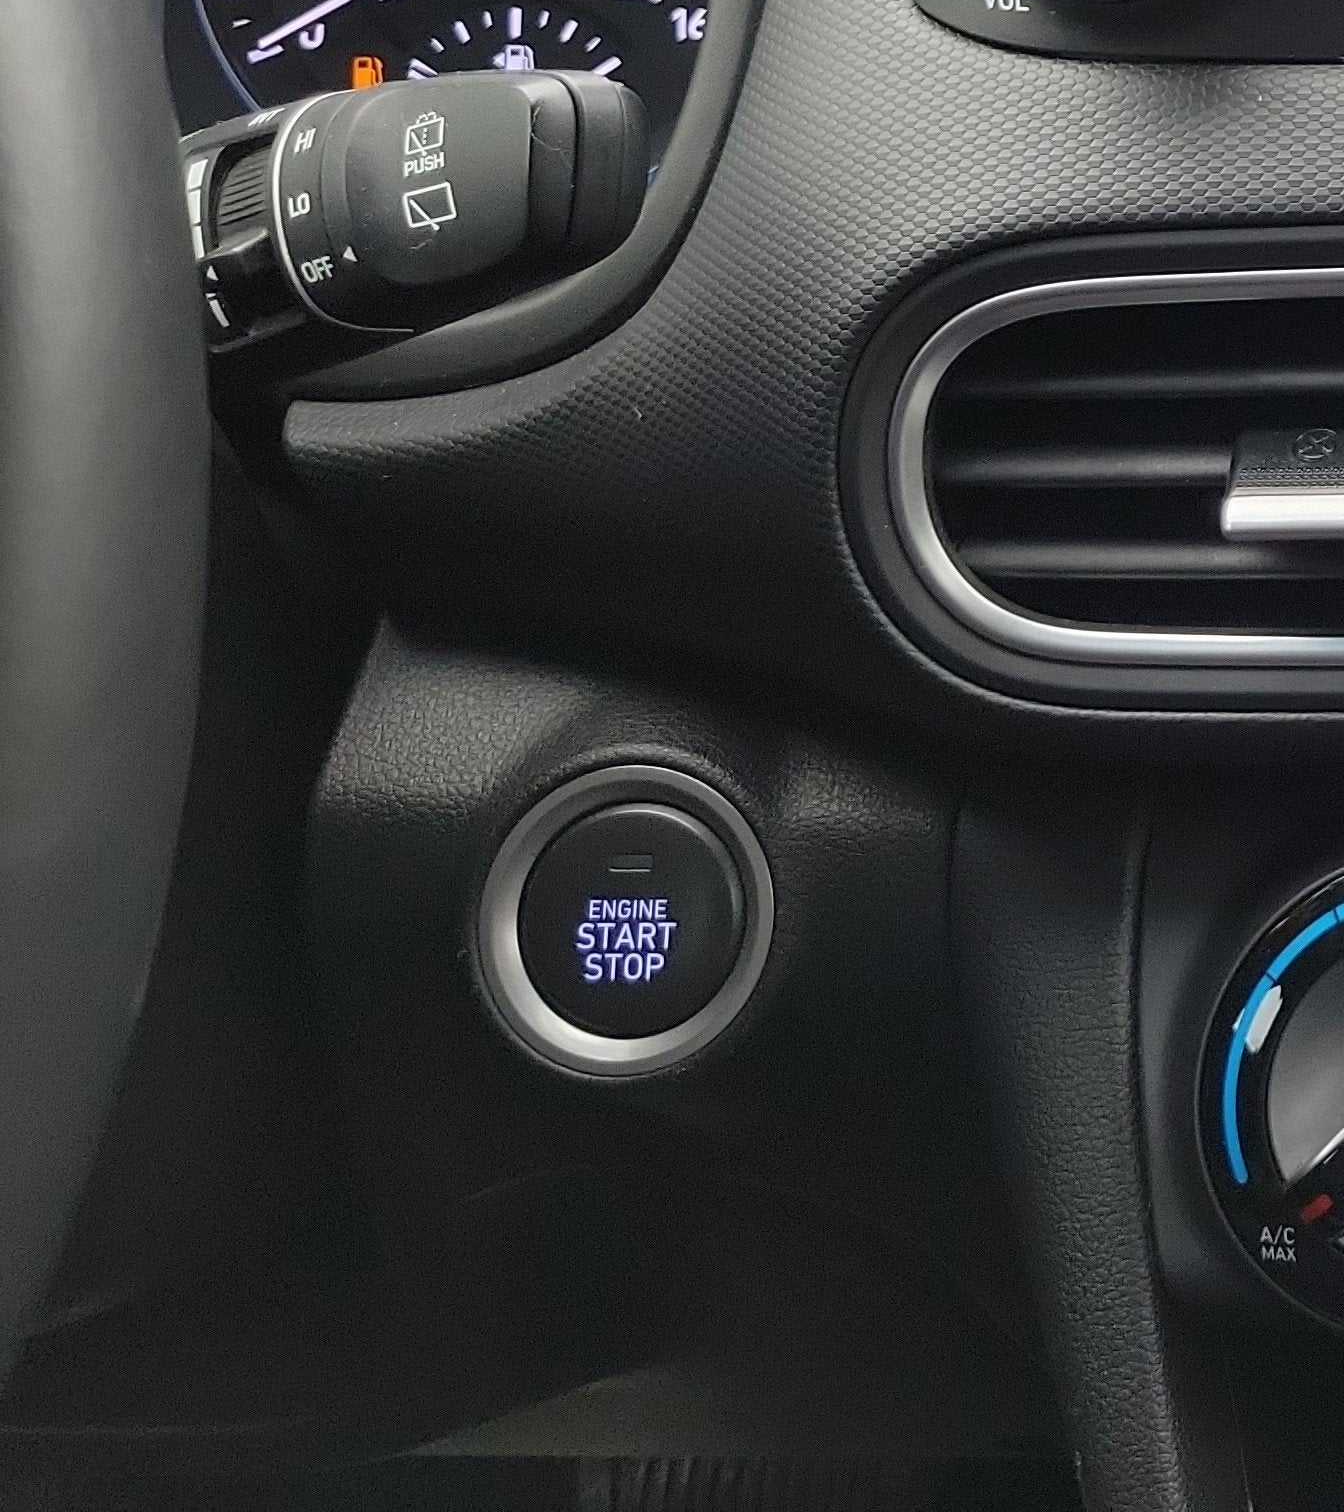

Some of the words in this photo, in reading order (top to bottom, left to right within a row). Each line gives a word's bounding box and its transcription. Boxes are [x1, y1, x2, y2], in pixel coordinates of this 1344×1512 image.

[293, 127, 317, 154] HI
[403, 155, 445, 178] PUSH
[287, 192, 311, 218] LO
[300, 255, 334, 283] OFF
[588, 899, 667, 920] ENGINE
[576, 921, 677, 951] START
[584, 952, 665, 981] STOP
[1259, 1226, 1295, 1245] A/C
[1261, 1245, 1297, 1262] MAX
